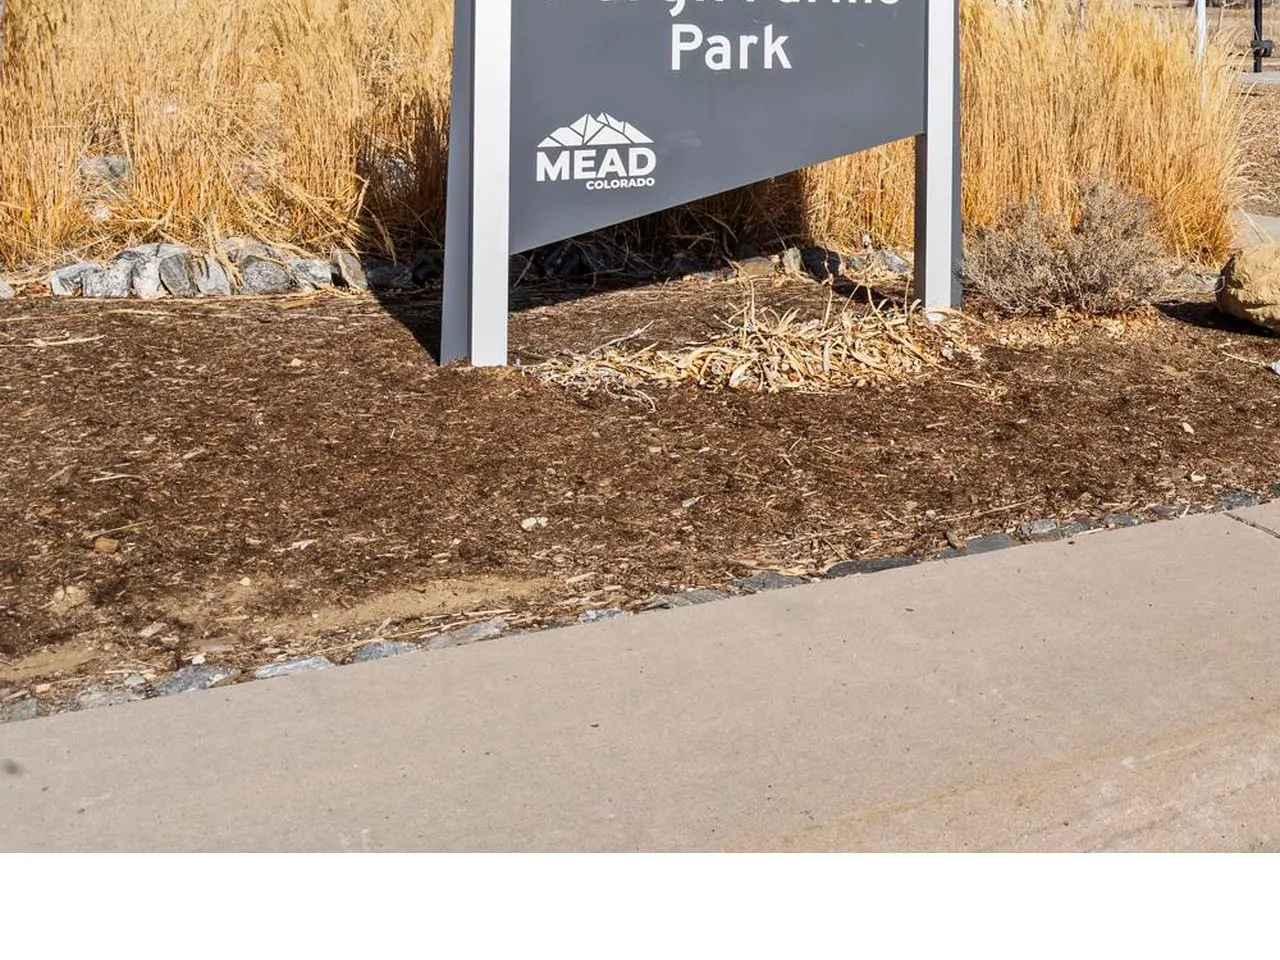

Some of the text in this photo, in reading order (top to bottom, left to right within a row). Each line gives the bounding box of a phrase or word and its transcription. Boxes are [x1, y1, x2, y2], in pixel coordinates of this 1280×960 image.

[671, 23, 793, 71] Park
[536, 147, 657, 182] MEAD
[586, 177, 656, 190] COLORADO
